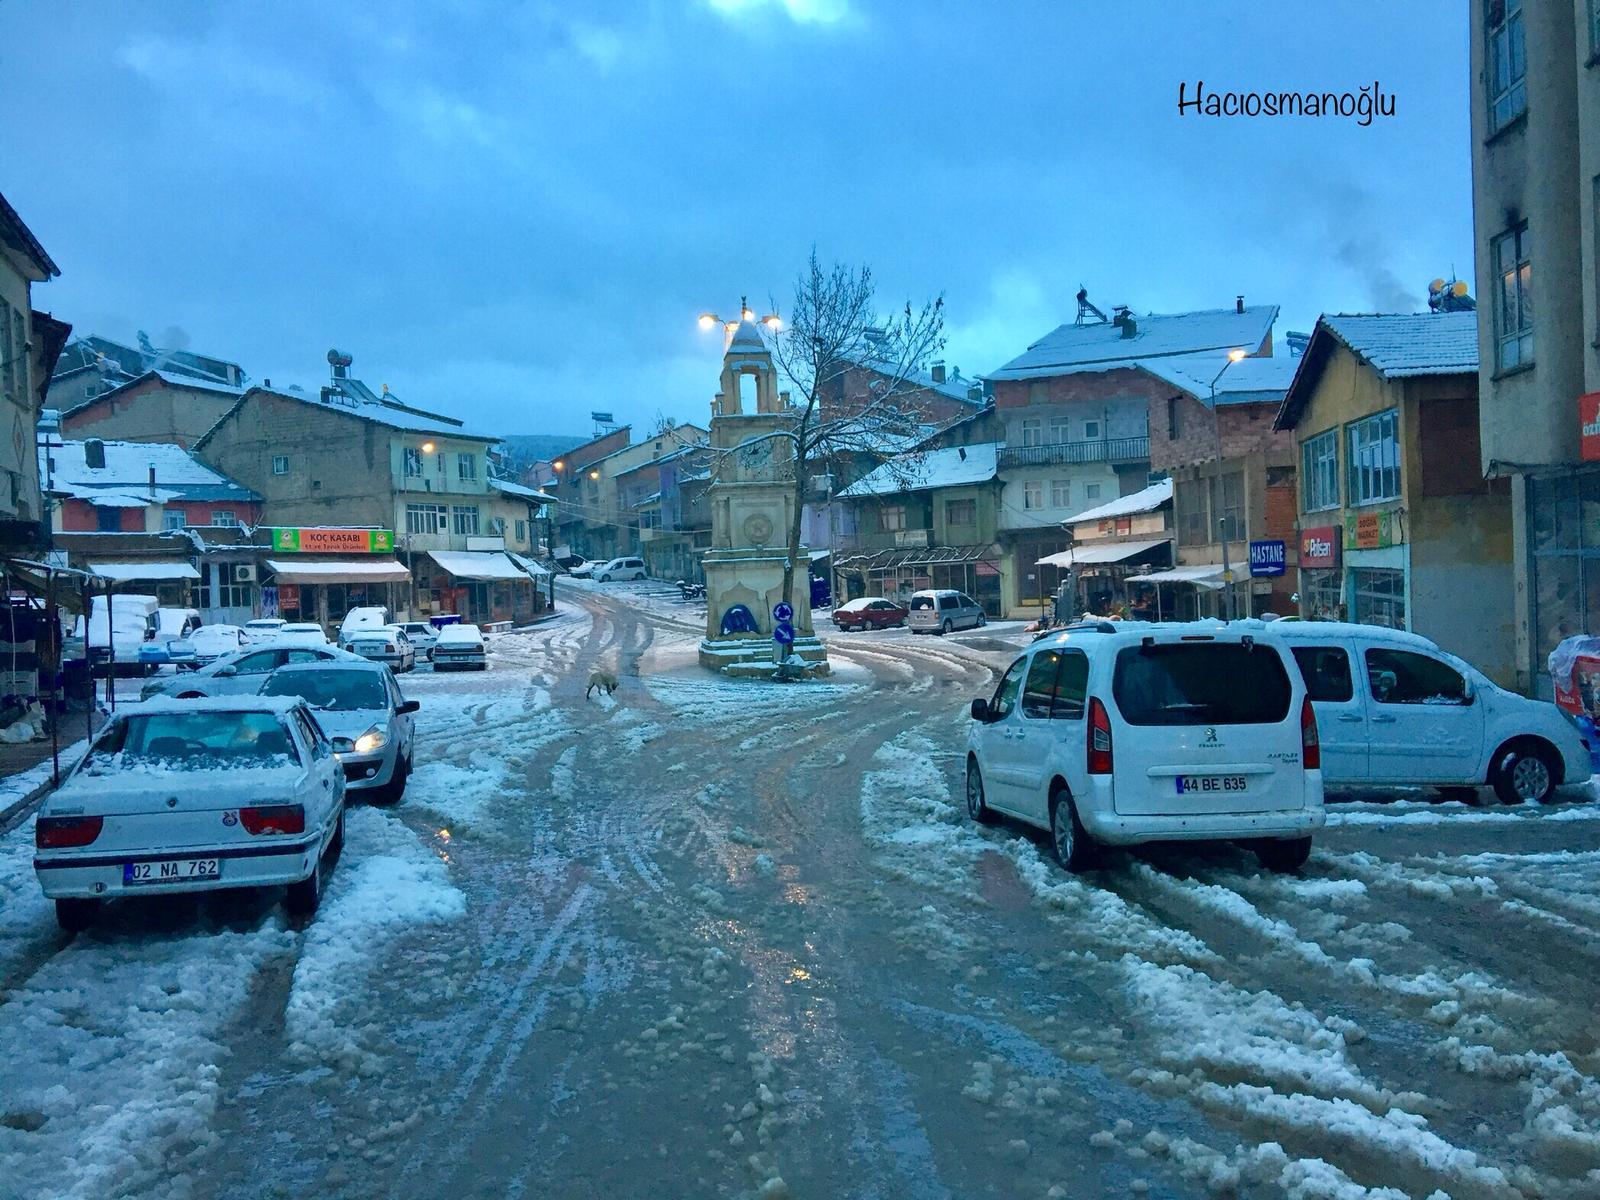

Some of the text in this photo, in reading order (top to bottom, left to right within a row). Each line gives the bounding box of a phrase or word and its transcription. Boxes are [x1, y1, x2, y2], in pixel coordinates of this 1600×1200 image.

[310, 533, 360, 543] KOÇ KASABI
[1251, 544, 1284, 564] HASTANE
[1183, 777, 1247, 792] 44 BE 635
[133, 860, 217, 879] 02 NA 762
